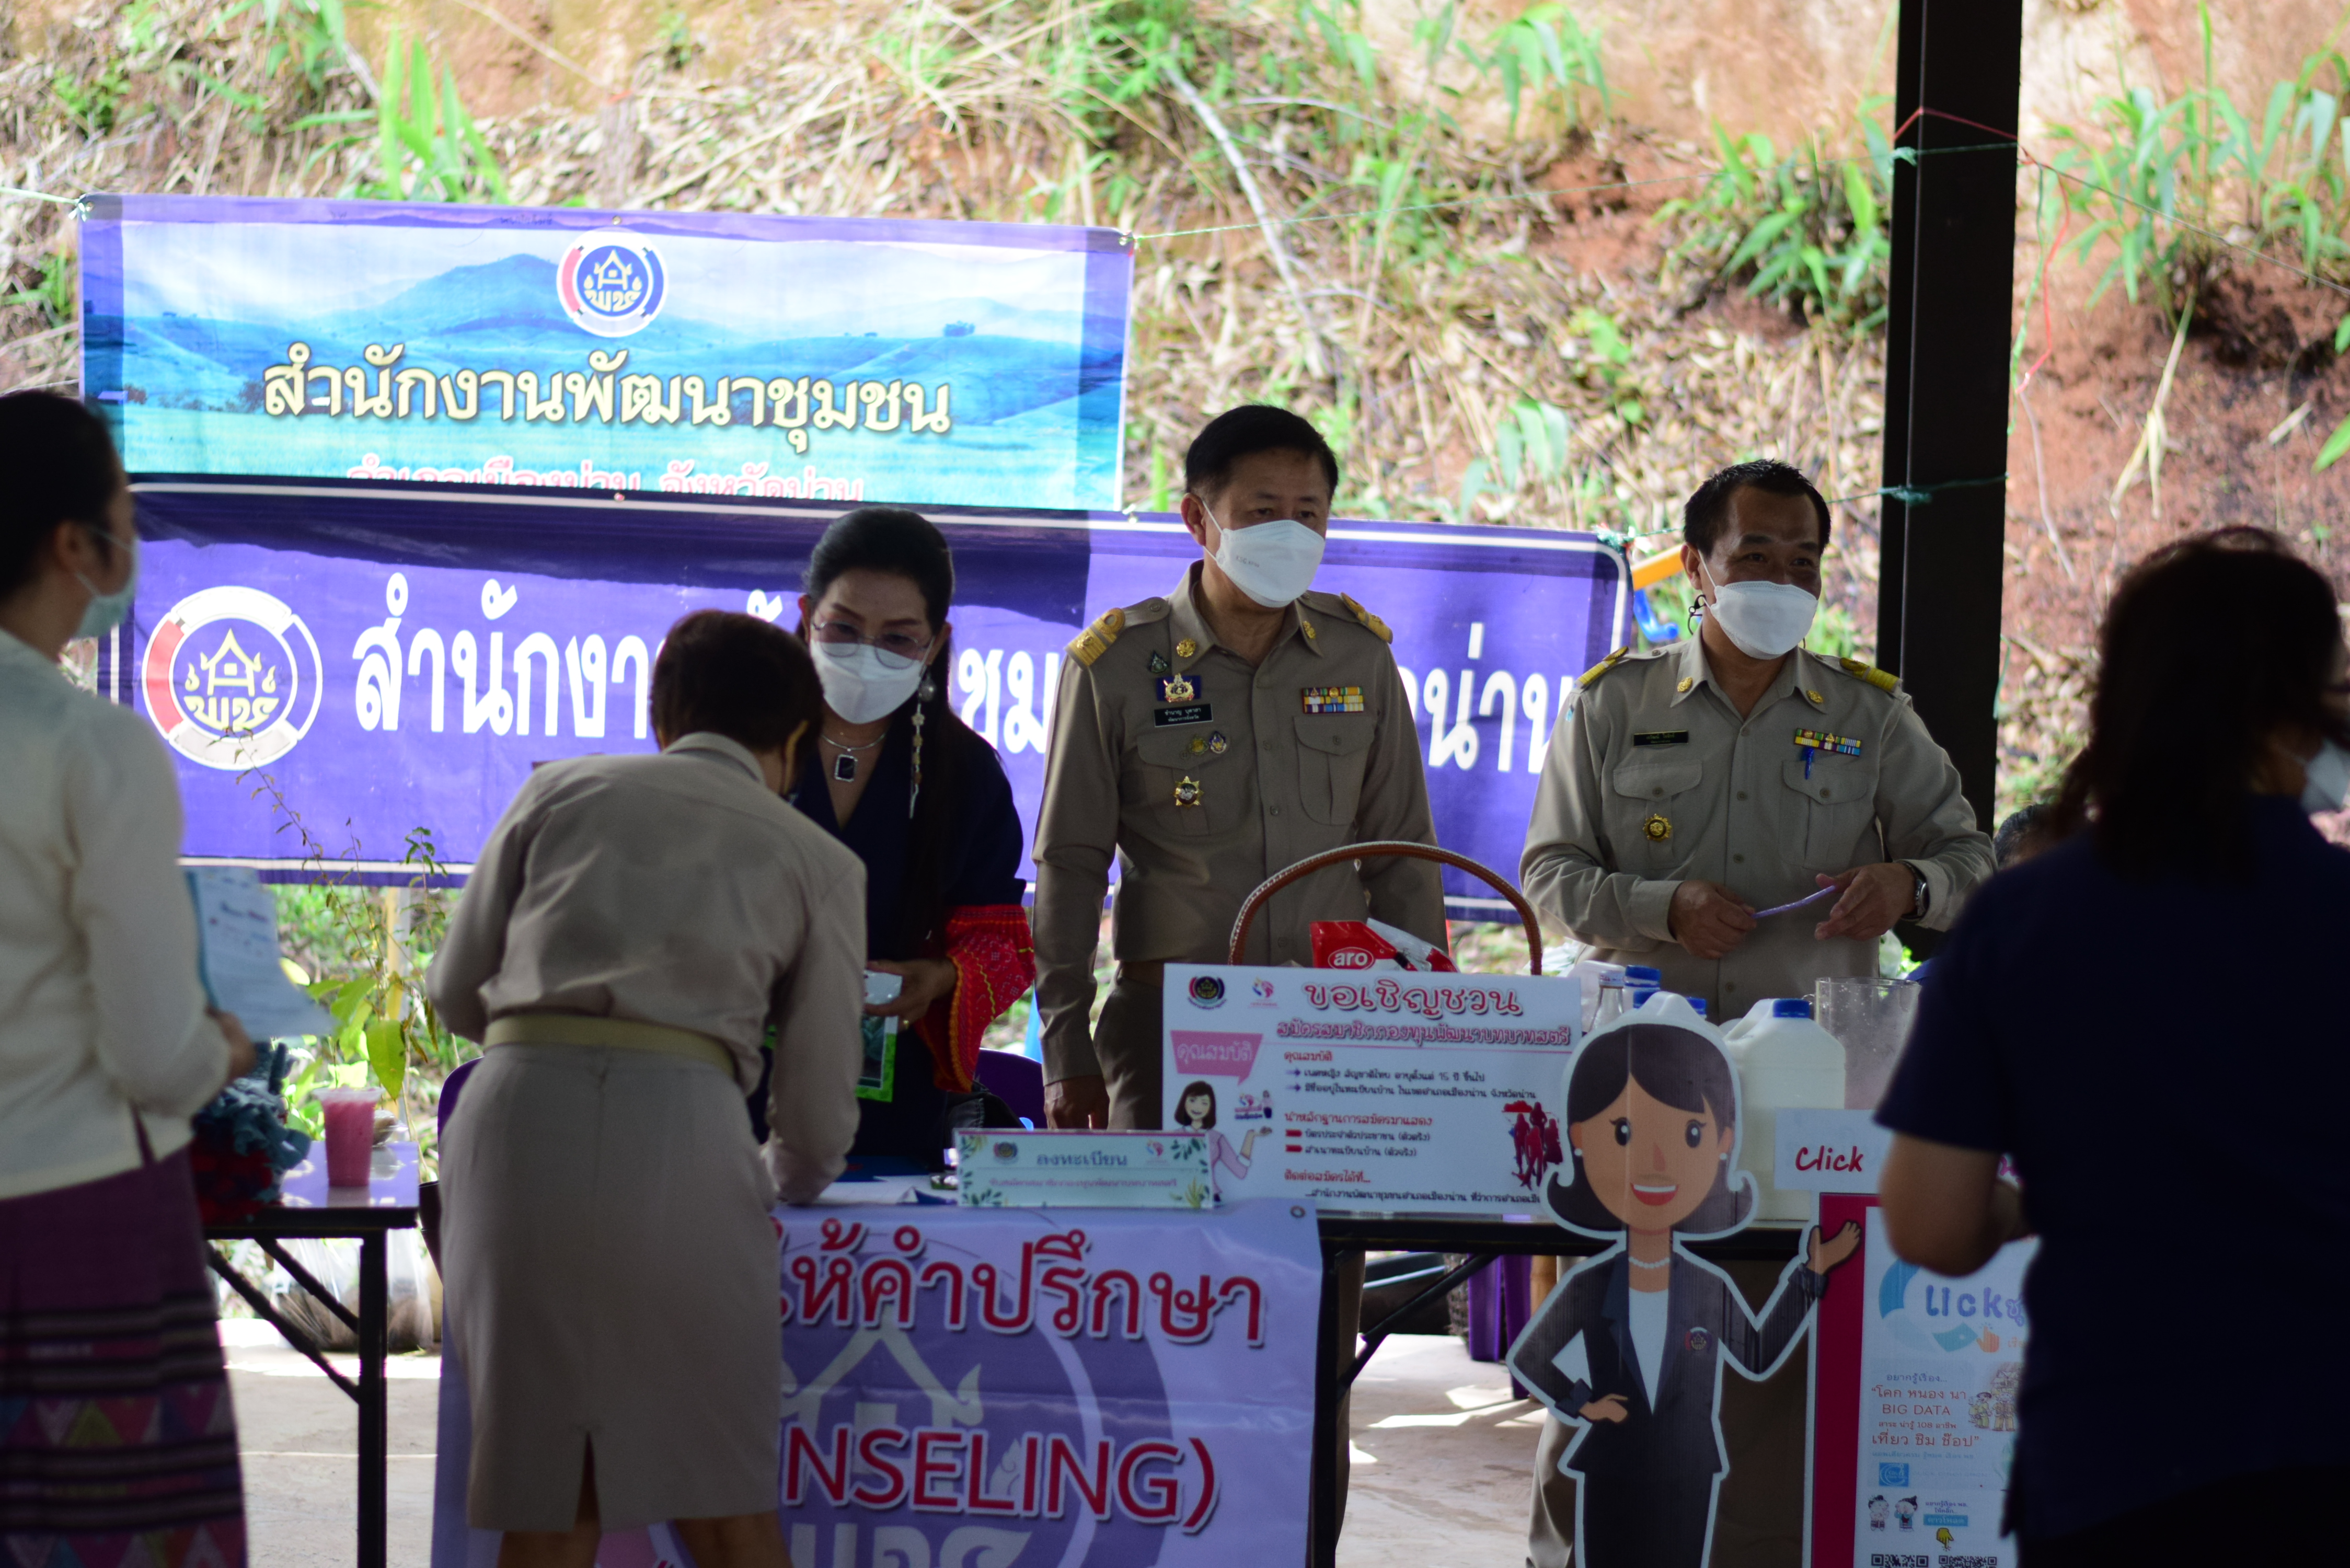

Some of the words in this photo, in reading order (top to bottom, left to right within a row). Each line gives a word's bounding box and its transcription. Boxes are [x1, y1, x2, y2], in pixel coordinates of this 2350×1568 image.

[263, 342, 951, 454] สำนักงานพัฒนาชุมชน
[1333, 952, 1368, 966] aro
[1304, 978, 1522, 1017] ขอเชิญชวน
[1276, 1018, 1570, 1046] สมัครสมาชิกกองทุนพัฒนาบทบาทสตรี
[1177, 1041, 1252, 1065] คุณสมบัติ
[1284, 1051, 1332, 1063] คุณสมบัติ
[1036, 1151, 1128, 1166] ลงทะเบียน
[1795, 1145, 1863, 1172] Click
[1908, 1389, 1944, 1399] หนอง
[1950, 1390, 1966, 1400] นา
[1882, 1404, 1908, 1414] BIG
[1914, 1405, 1951, 1416] DATA
[1872, 1428, 1908, 1445] เที่ยว
[1915, 1433, 1935, 1446] ชิม
